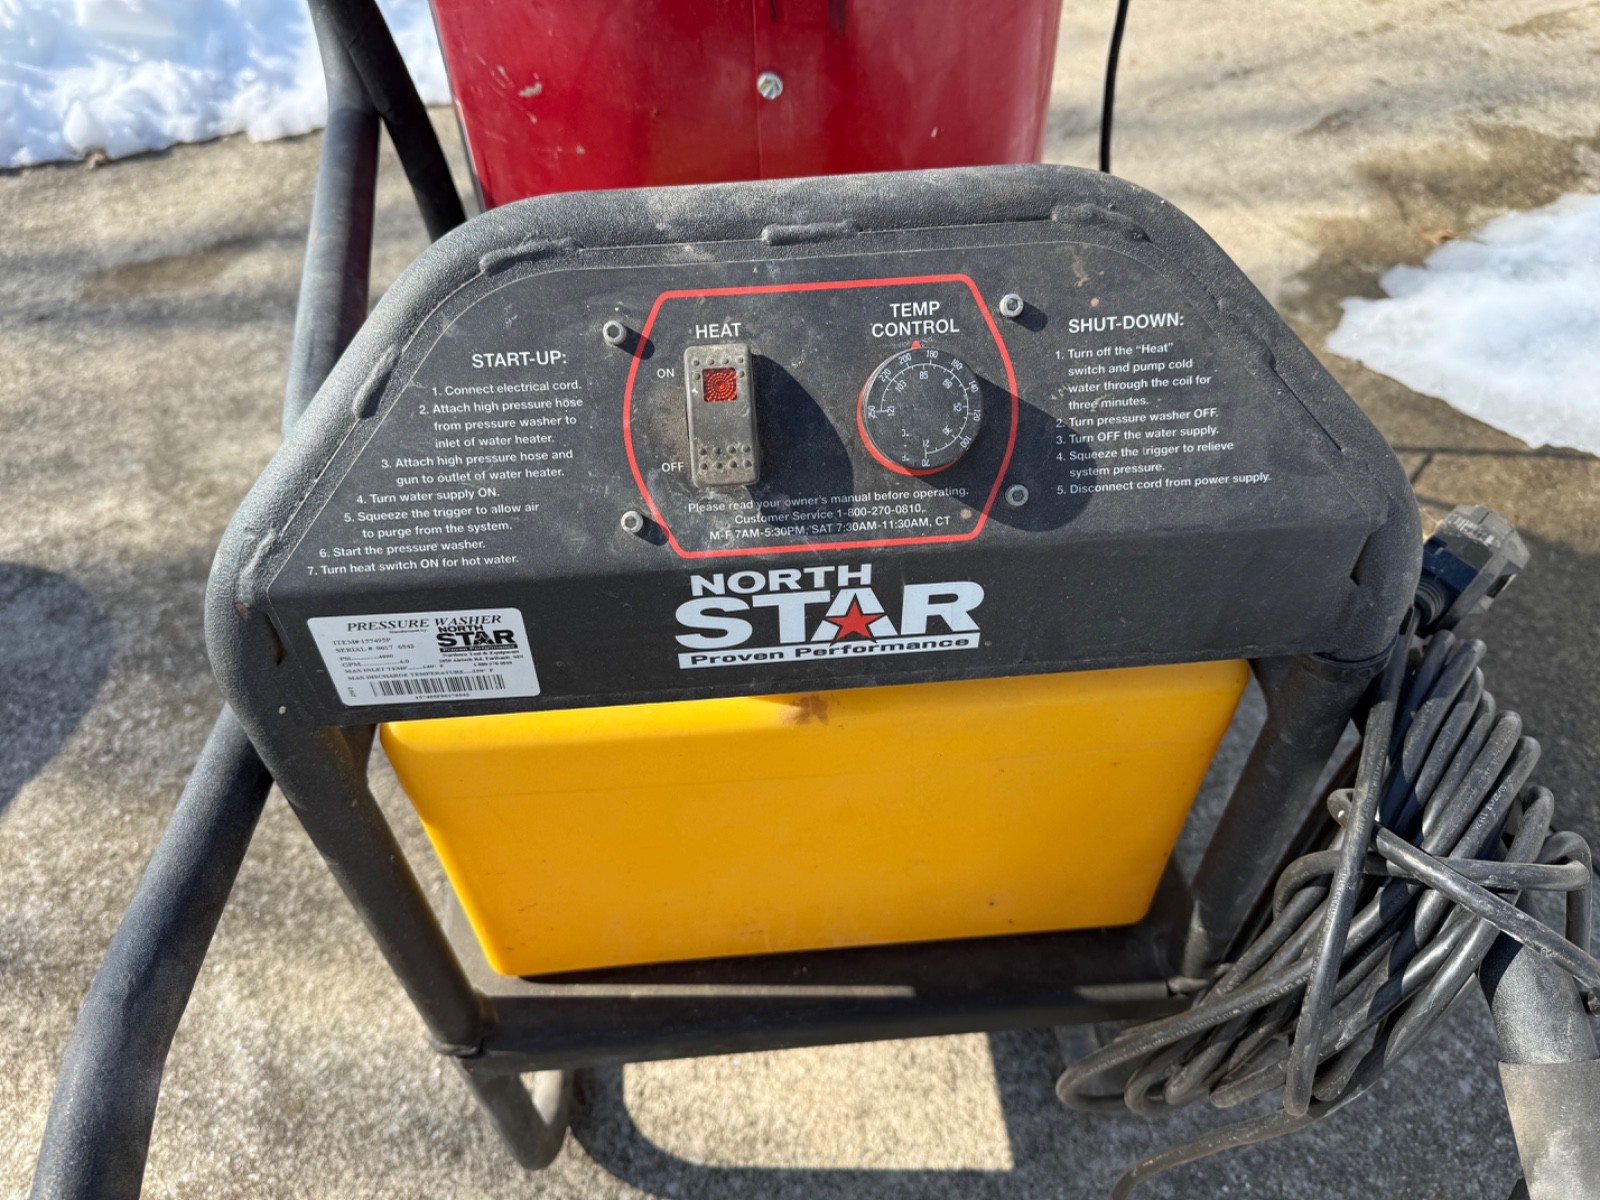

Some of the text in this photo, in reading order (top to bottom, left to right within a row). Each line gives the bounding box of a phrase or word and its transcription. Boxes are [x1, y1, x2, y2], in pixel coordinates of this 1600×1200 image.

[890, 301, 940, 318] TEMP
[695, 323, 741, 338] HEAT
[871, 319, 960, 338] CONTROL
[1068, 313, 1184, 333] SHUT-DOWN:
[472, 350, 566, 368] START-UP:
[898, 353, 912, 364] 200
[1055, 350, 1064, 359] 1.
[1067, 348, 1093, 359] Turn
[1096, 346, 1111, 357] off
[1114, 345, 1133, 355] the
[951, 359, 963, 370] 160
[1068, 358, 1193, 376] switch and pump cold
[657, 368, 675, 379] ON
[879, 369, 891, 382] 220
[920, 371, 928, 379] 85
[431, 379, 581, 396] 1. Connect electrical cord.
[895, 381, 907, 392] 103
[1068, 374, 1211, 393] water through the coil for
[418, 398, 583, 414] 2. Attach high pressure hose
[953, 402, 962, 412] 52
[1068, 397, 1149, 410] three minutes.
[433, 415, 576, 432] from pressure washer to
[1055, 407, 1218, 429] 2. Turn pressure washer OFF.
[435, 434, 554, 448] inlet of water heater.
[960, 435, 971, 448] 100
[1055, 424, 1219, 445] 3. Turn OFF the water supply.
[381, 449, 573, 468] 3. Attach high pressure hose and
[1056, 441, 1234, 461] 4. Squeeze the trigger to relieve
[661, 462, 684, 472] OFF
[1069, 463, 1165, 480] system pressure.
[396, 467, 564, 487] gun to outlet of water heater.
[1056, 471, 1271, 495] 5. Disconnect cord from power supply.
[356, 487, 500, 504] 4. Turn water supply ON.
[688, 487, 968, 513] Please read your owner's manual before operating.
[344, 501, 539, 522] 5. Squeeze the trigger to allow air
[734, 512, 790, 524] Customer
[792, 509, 833, 520] Service
[362, 522, 512, 539] to purge from the system.
[710, 530, 732, 540] M-F
[812, 523, 833, 534] SAT
[935, 516, 950, 526] CT
[318, 539, 485, 558] 6. Start the pressure washer.
[306, 554, 518, 575] 7. Turn heat switch ON for hot water.
[690, 564, 872, 596] NORTH
[347, 618, 429, 632] PRESSURE
[435, 615, 502, 626] WASHER
[674, 581, 984, 649] STAR
[436, 630, 516, 646] STAR
[691, 637, 970, 666] Proven Performance
